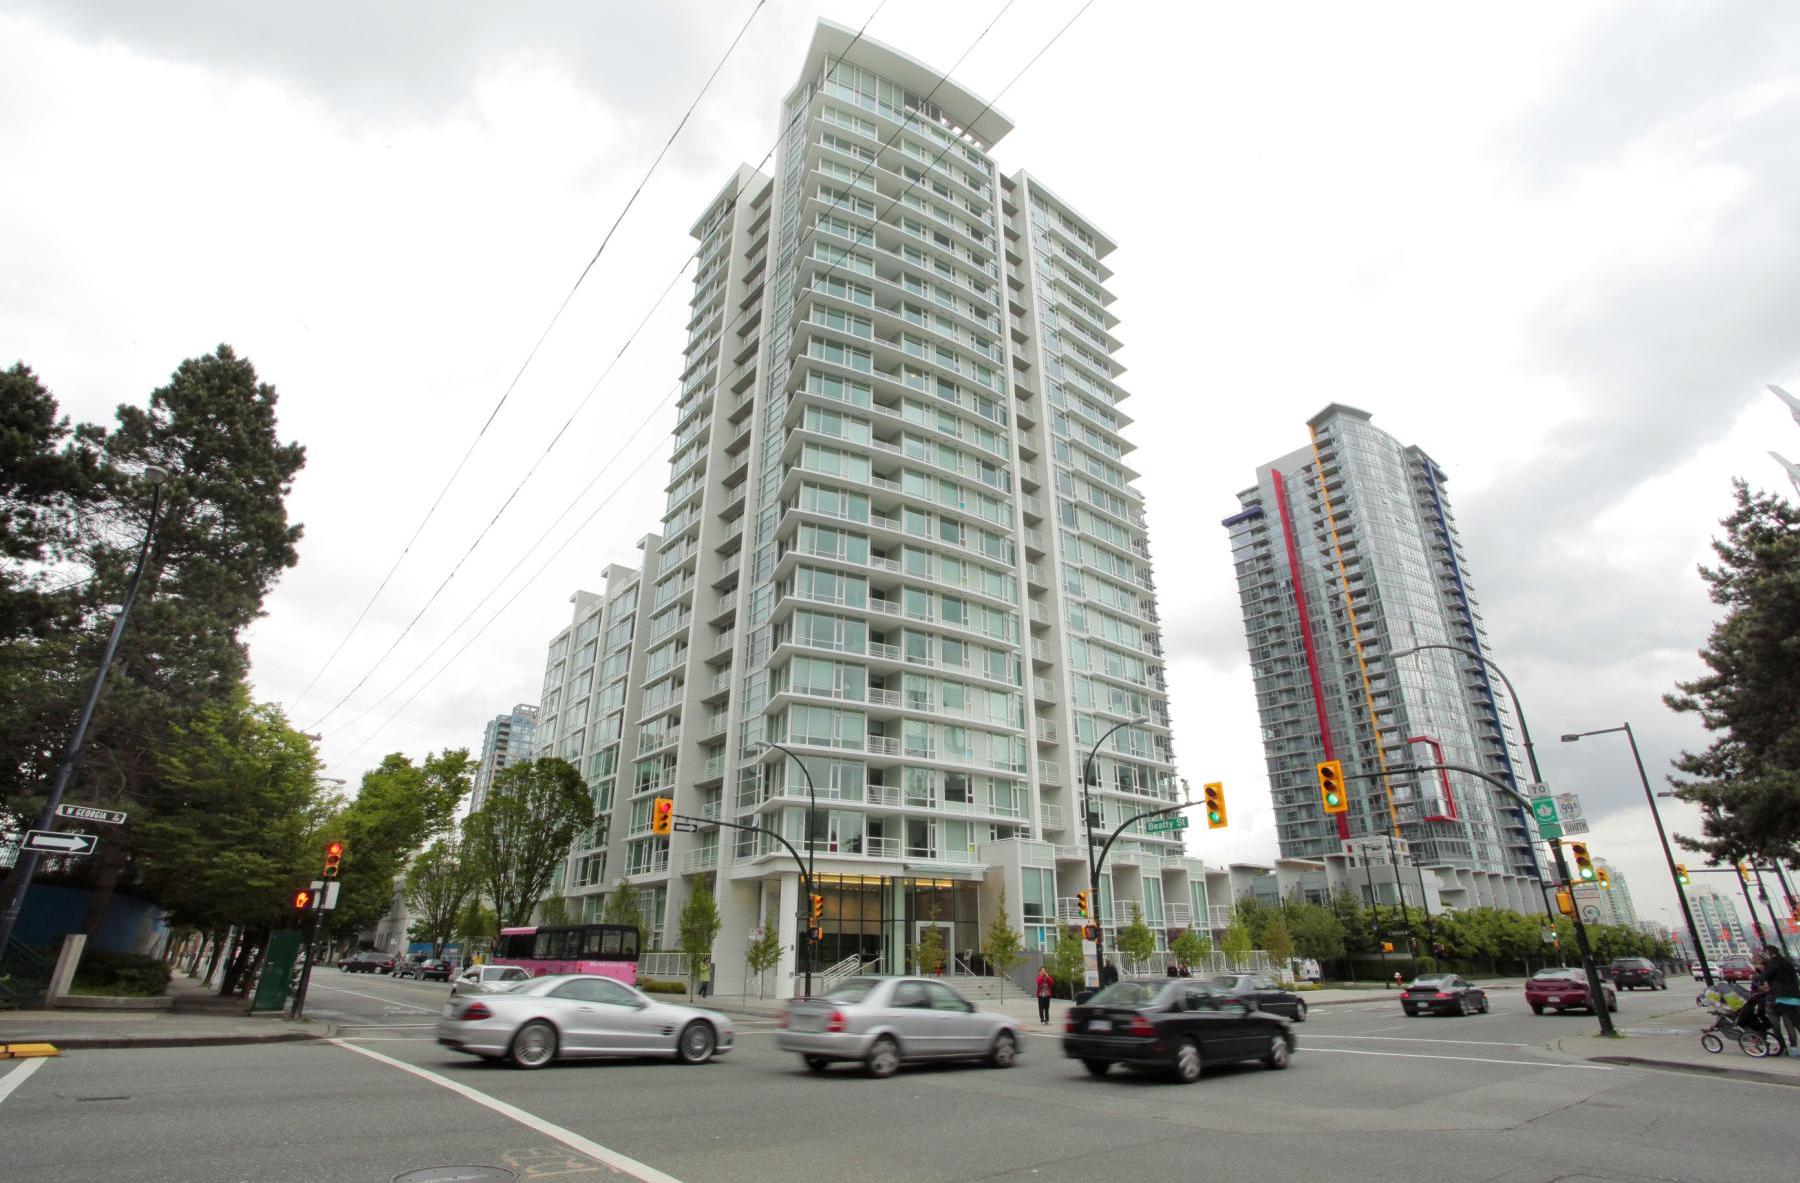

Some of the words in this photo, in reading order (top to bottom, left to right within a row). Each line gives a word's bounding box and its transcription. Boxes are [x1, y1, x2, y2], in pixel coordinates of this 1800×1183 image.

[1531, 785, 1546, 794] TO
[76, 808, 107, 820] GEORGIA
[1148, 821, 1173, 830] Beatty
[1176, 818, 1186, 827] St
[1563, 822, 1589, 833] SOUTH
